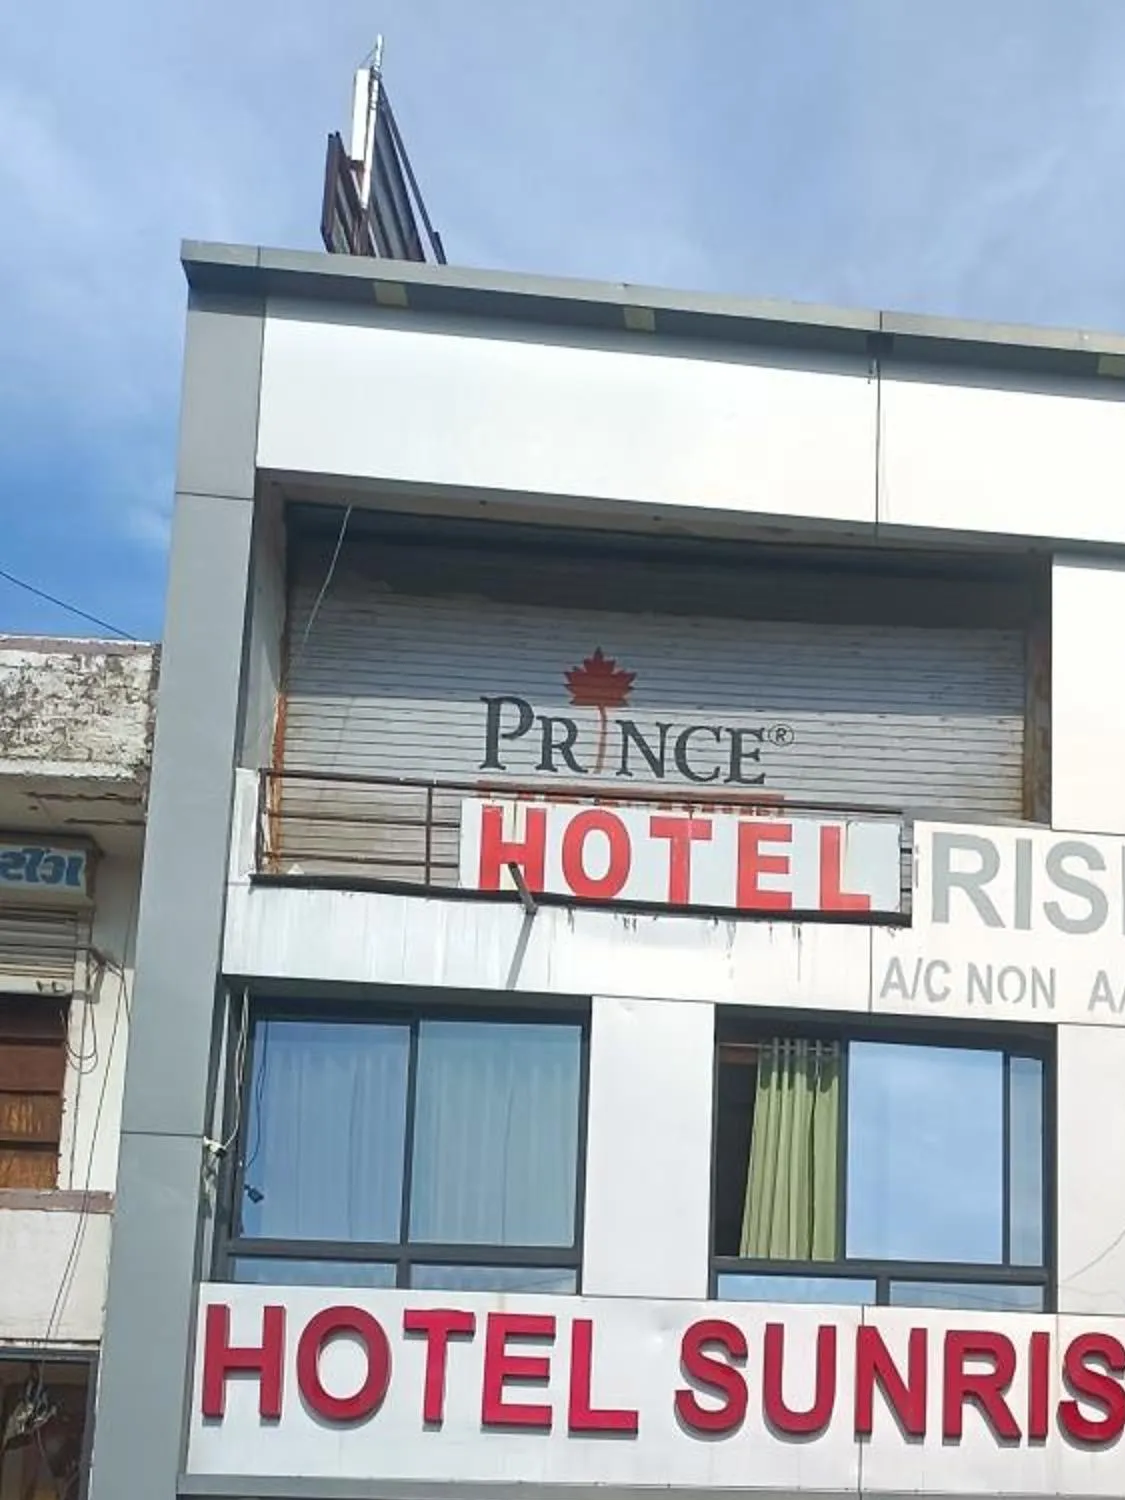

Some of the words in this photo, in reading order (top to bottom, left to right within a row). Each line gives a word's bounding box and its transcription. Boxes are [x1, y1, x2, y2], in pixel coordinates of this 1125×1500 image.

[478, 803, 871, 912] HOTEL
[880, 957, 952, 1003] A/C
[966, 962, 1056, 1010] NON
[201, 1303, 639, 1433] HOTEL
